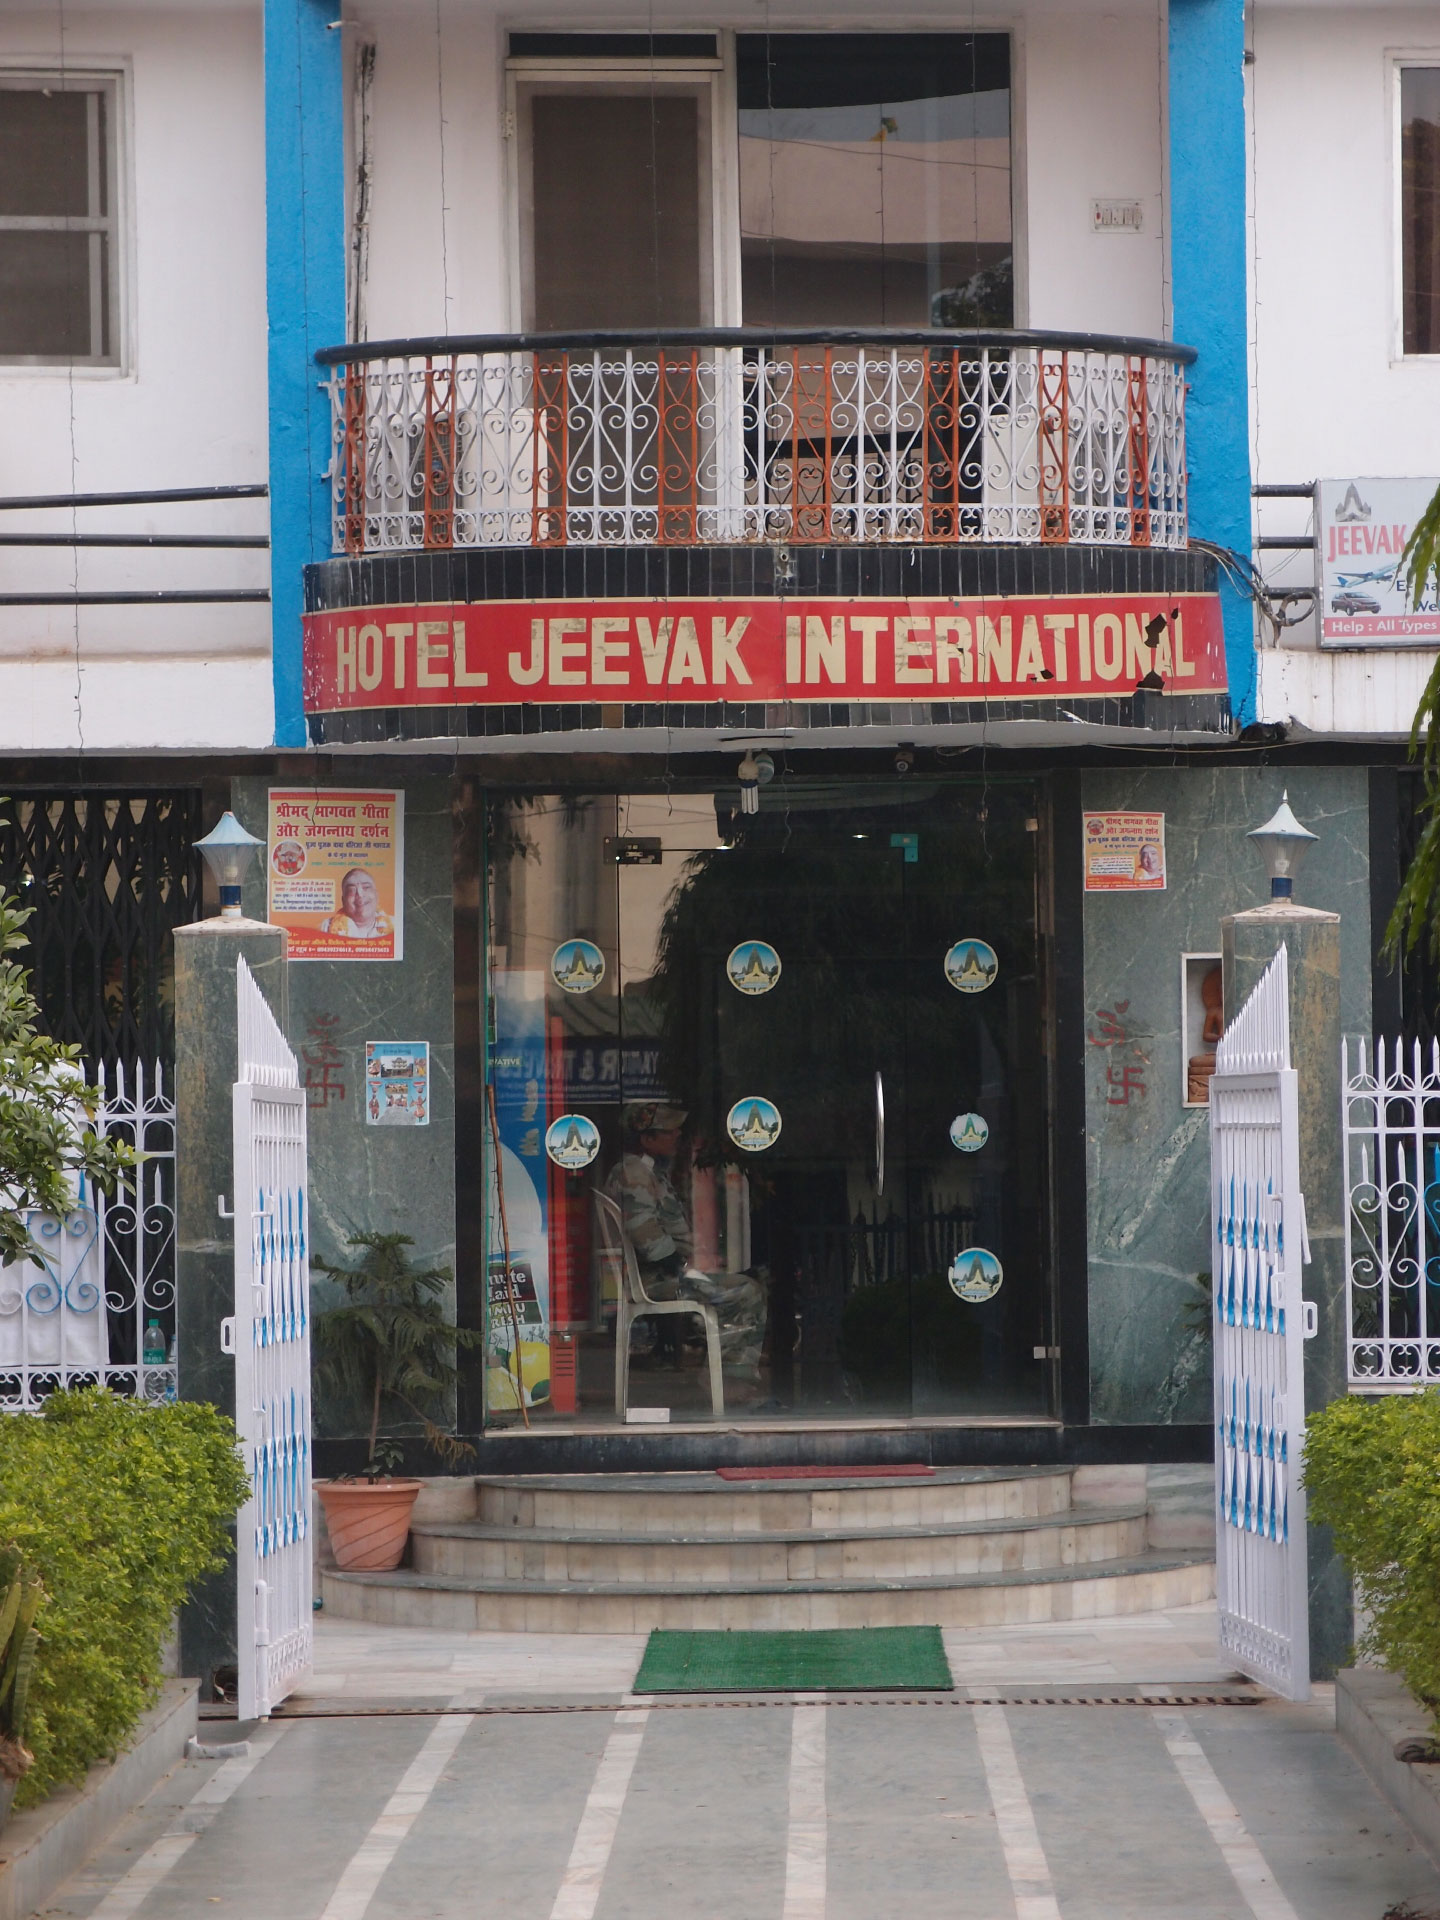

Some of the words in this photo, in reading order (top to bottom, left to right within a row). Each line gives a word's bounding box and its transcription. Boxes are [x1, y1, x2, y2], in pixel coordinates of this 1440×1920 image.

[1328, 524, 1406, 562] JEEVAK
[1332, 621, 1364, 634] Help
[1376, 619, 1394, 631] All
[1398, 619, 1438, 634] Types
[337, 620, 488, 693] HOTEL
[508, 616, 753, 686] JEEVAK
[785, 612, 1195, 685] INTERNATIONAL
[361, 803, 390, 819] गीता
[360, 823, 389, 838] दर्शन
